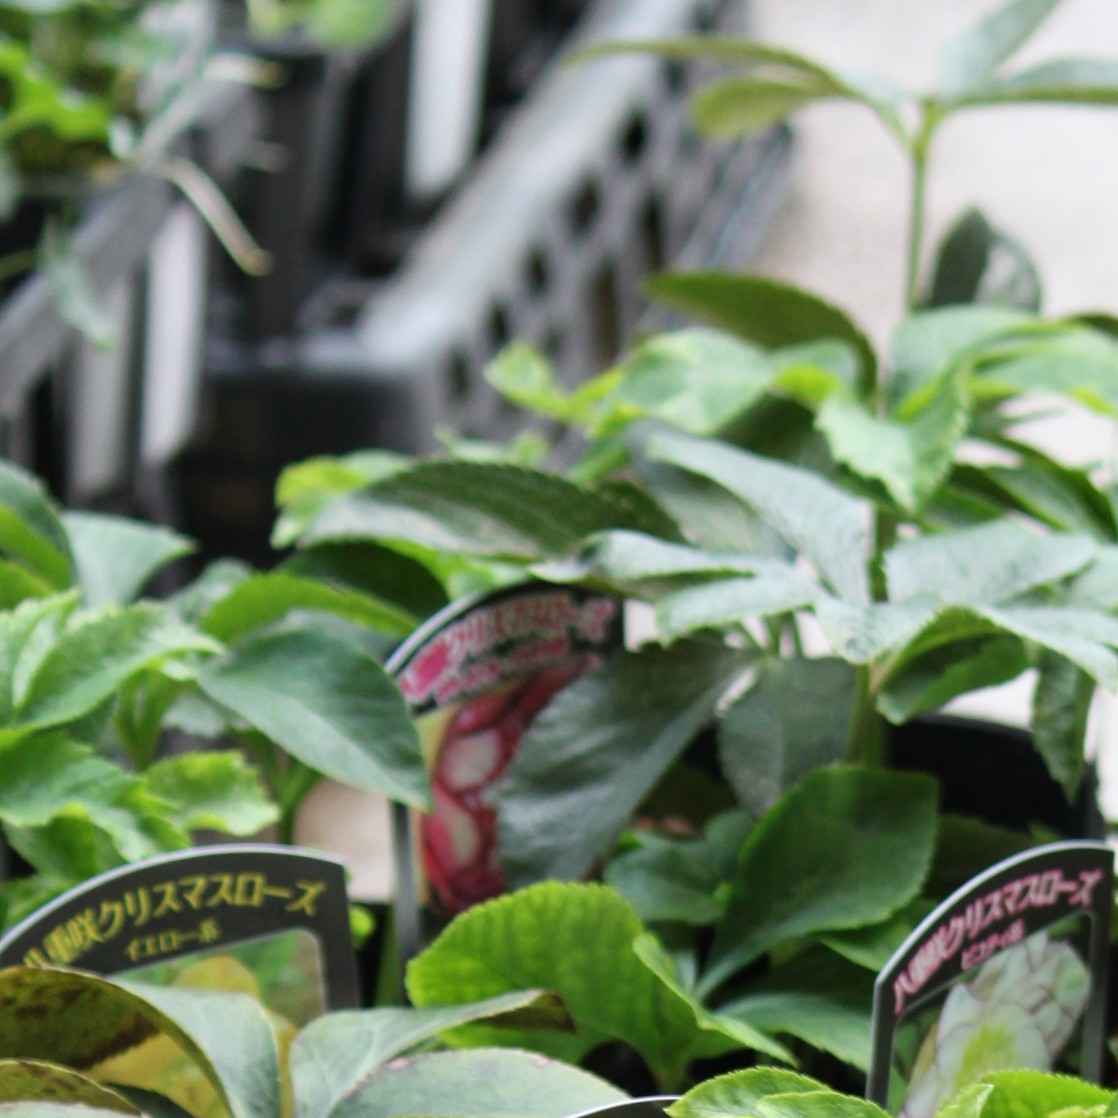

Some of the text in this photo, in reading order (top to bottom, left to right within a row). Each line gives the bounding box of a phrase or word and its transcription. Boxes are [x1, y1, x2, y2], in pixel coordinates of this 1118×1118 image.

[894, 868, 1103, 1016] 八重咲クリスマスローズ
